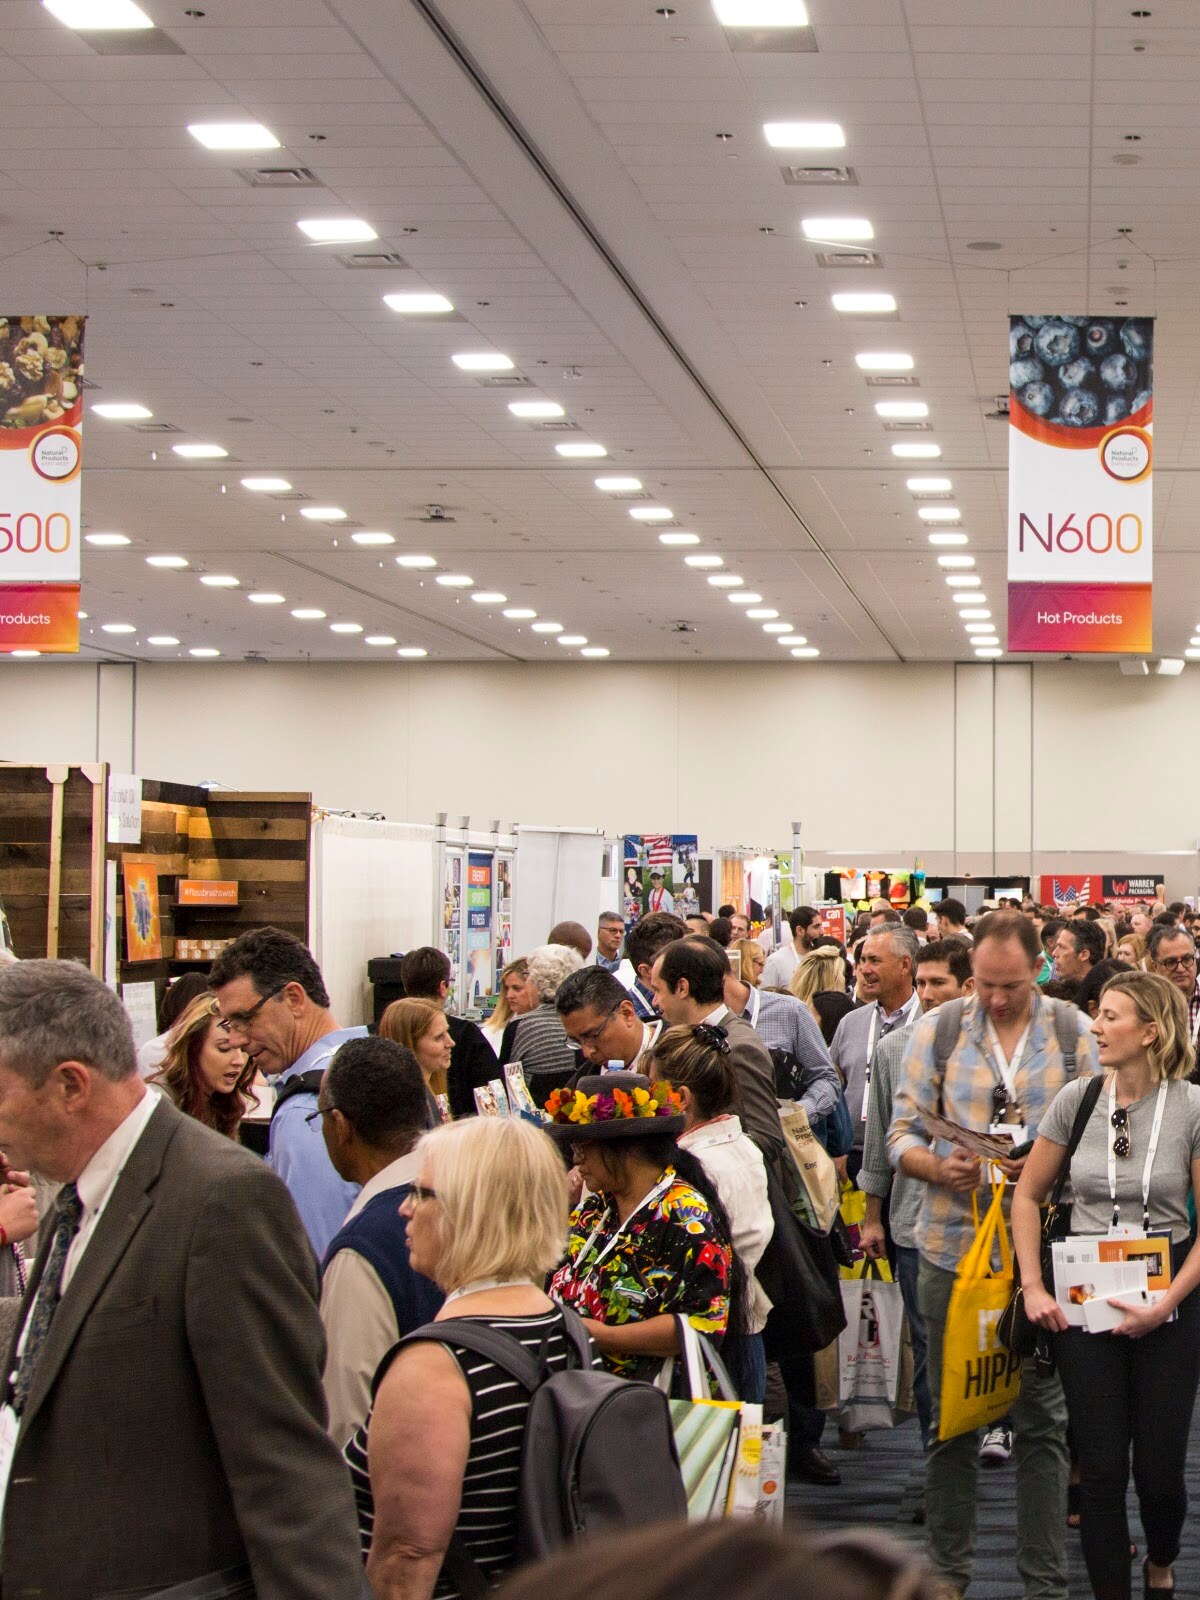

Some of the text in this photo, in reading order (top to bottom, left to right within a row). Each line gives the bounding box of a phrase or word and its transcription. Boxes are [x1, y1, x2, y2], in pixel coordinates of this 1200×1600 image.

[1019, 512, 1143, 554] N600
[0, 613, 51, 625] roducts
[1037, 612, 1123, 625] Hot Products
[1128, 879, 1155, 888] WARREN
